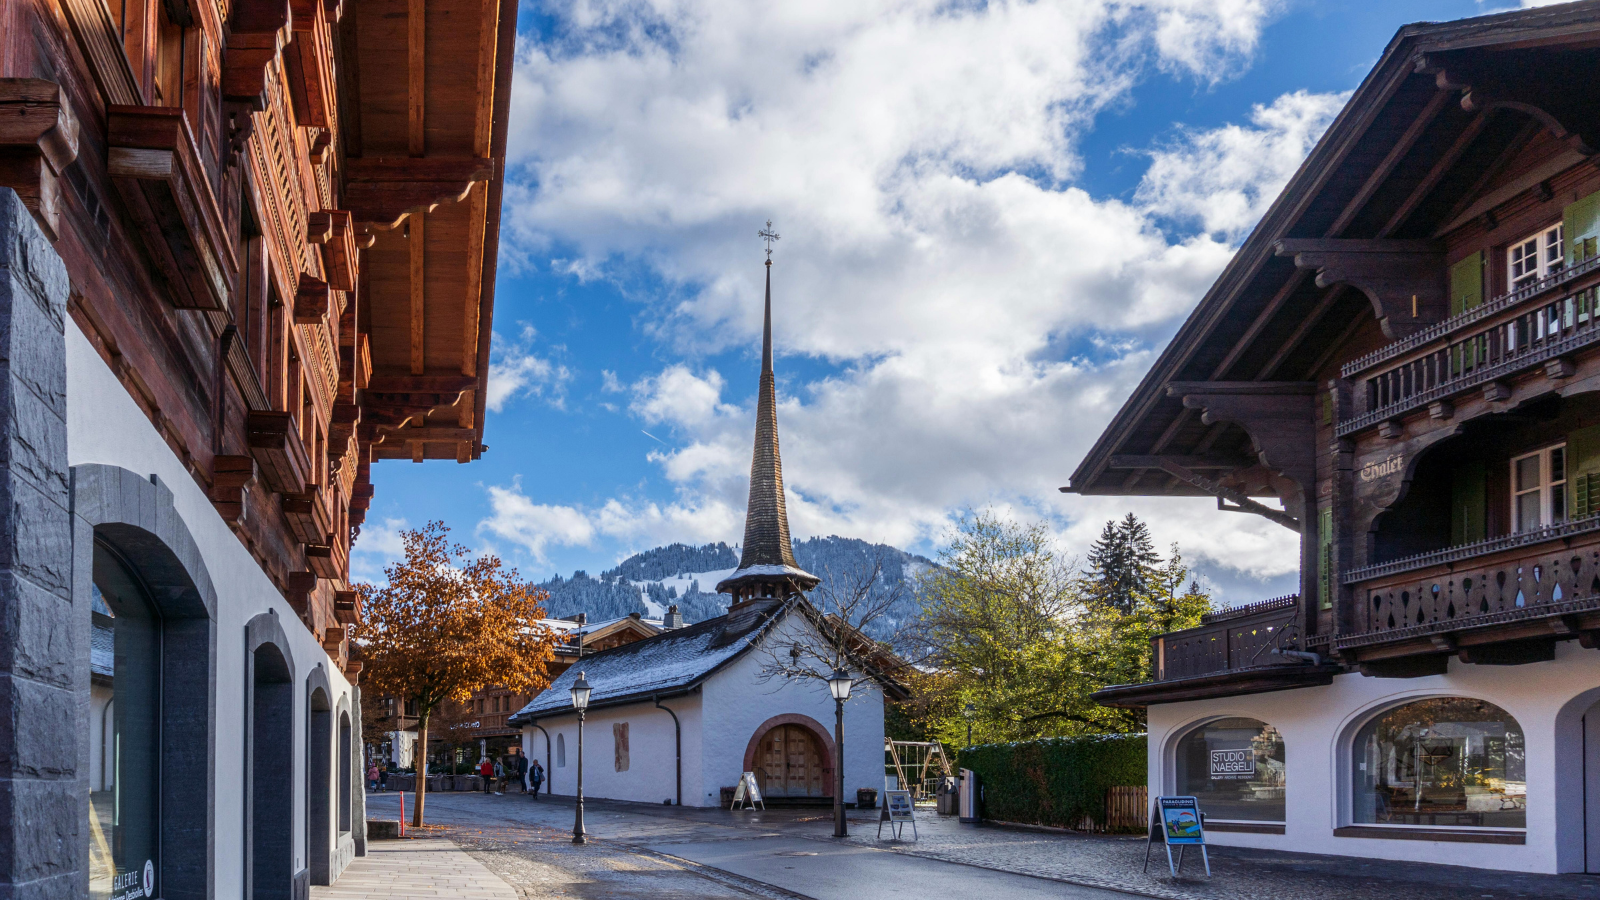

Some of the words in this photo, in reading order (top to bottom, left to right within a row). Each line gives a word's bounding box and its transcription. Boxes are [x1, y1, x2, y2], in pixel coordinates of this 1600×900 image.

[1361, 453, 1404, 482] Chalet
[1212, 752, 1244, 762] STUDIO
[1213, 762, 1252, 771] NAEGELI
[114, 870, 138, 890] GALERIE
